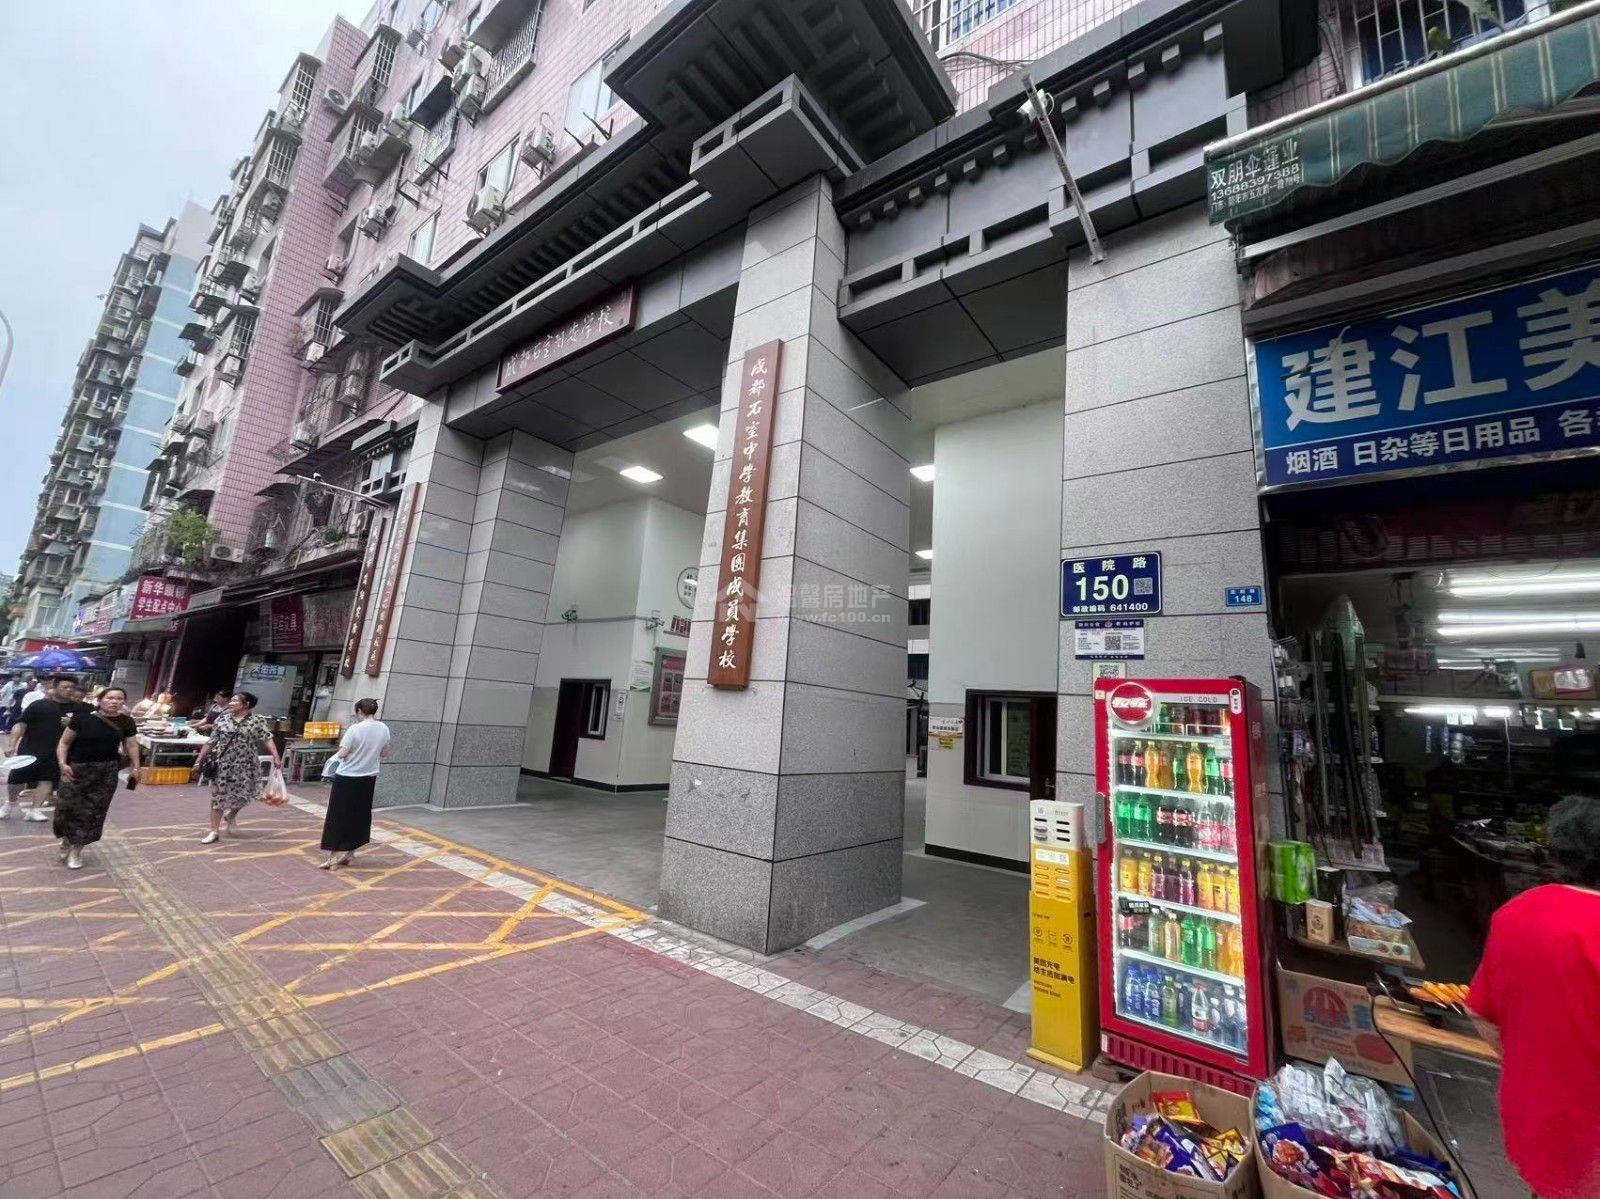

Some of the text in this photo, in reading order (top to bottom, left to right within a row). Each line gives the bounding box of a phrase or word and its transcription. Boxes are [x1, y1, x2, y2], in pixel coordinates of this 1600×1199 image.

[1210, 163, 1300, 202] 13688397388
[1285, 409, 1600, 475] 烟酒 日杂等日用品 各
[1072, 556, 1147, 574] 医院路
[1075, 574, 1130, 602] 150
[1072, 602, 1149, 613] 邮政编码 641400
